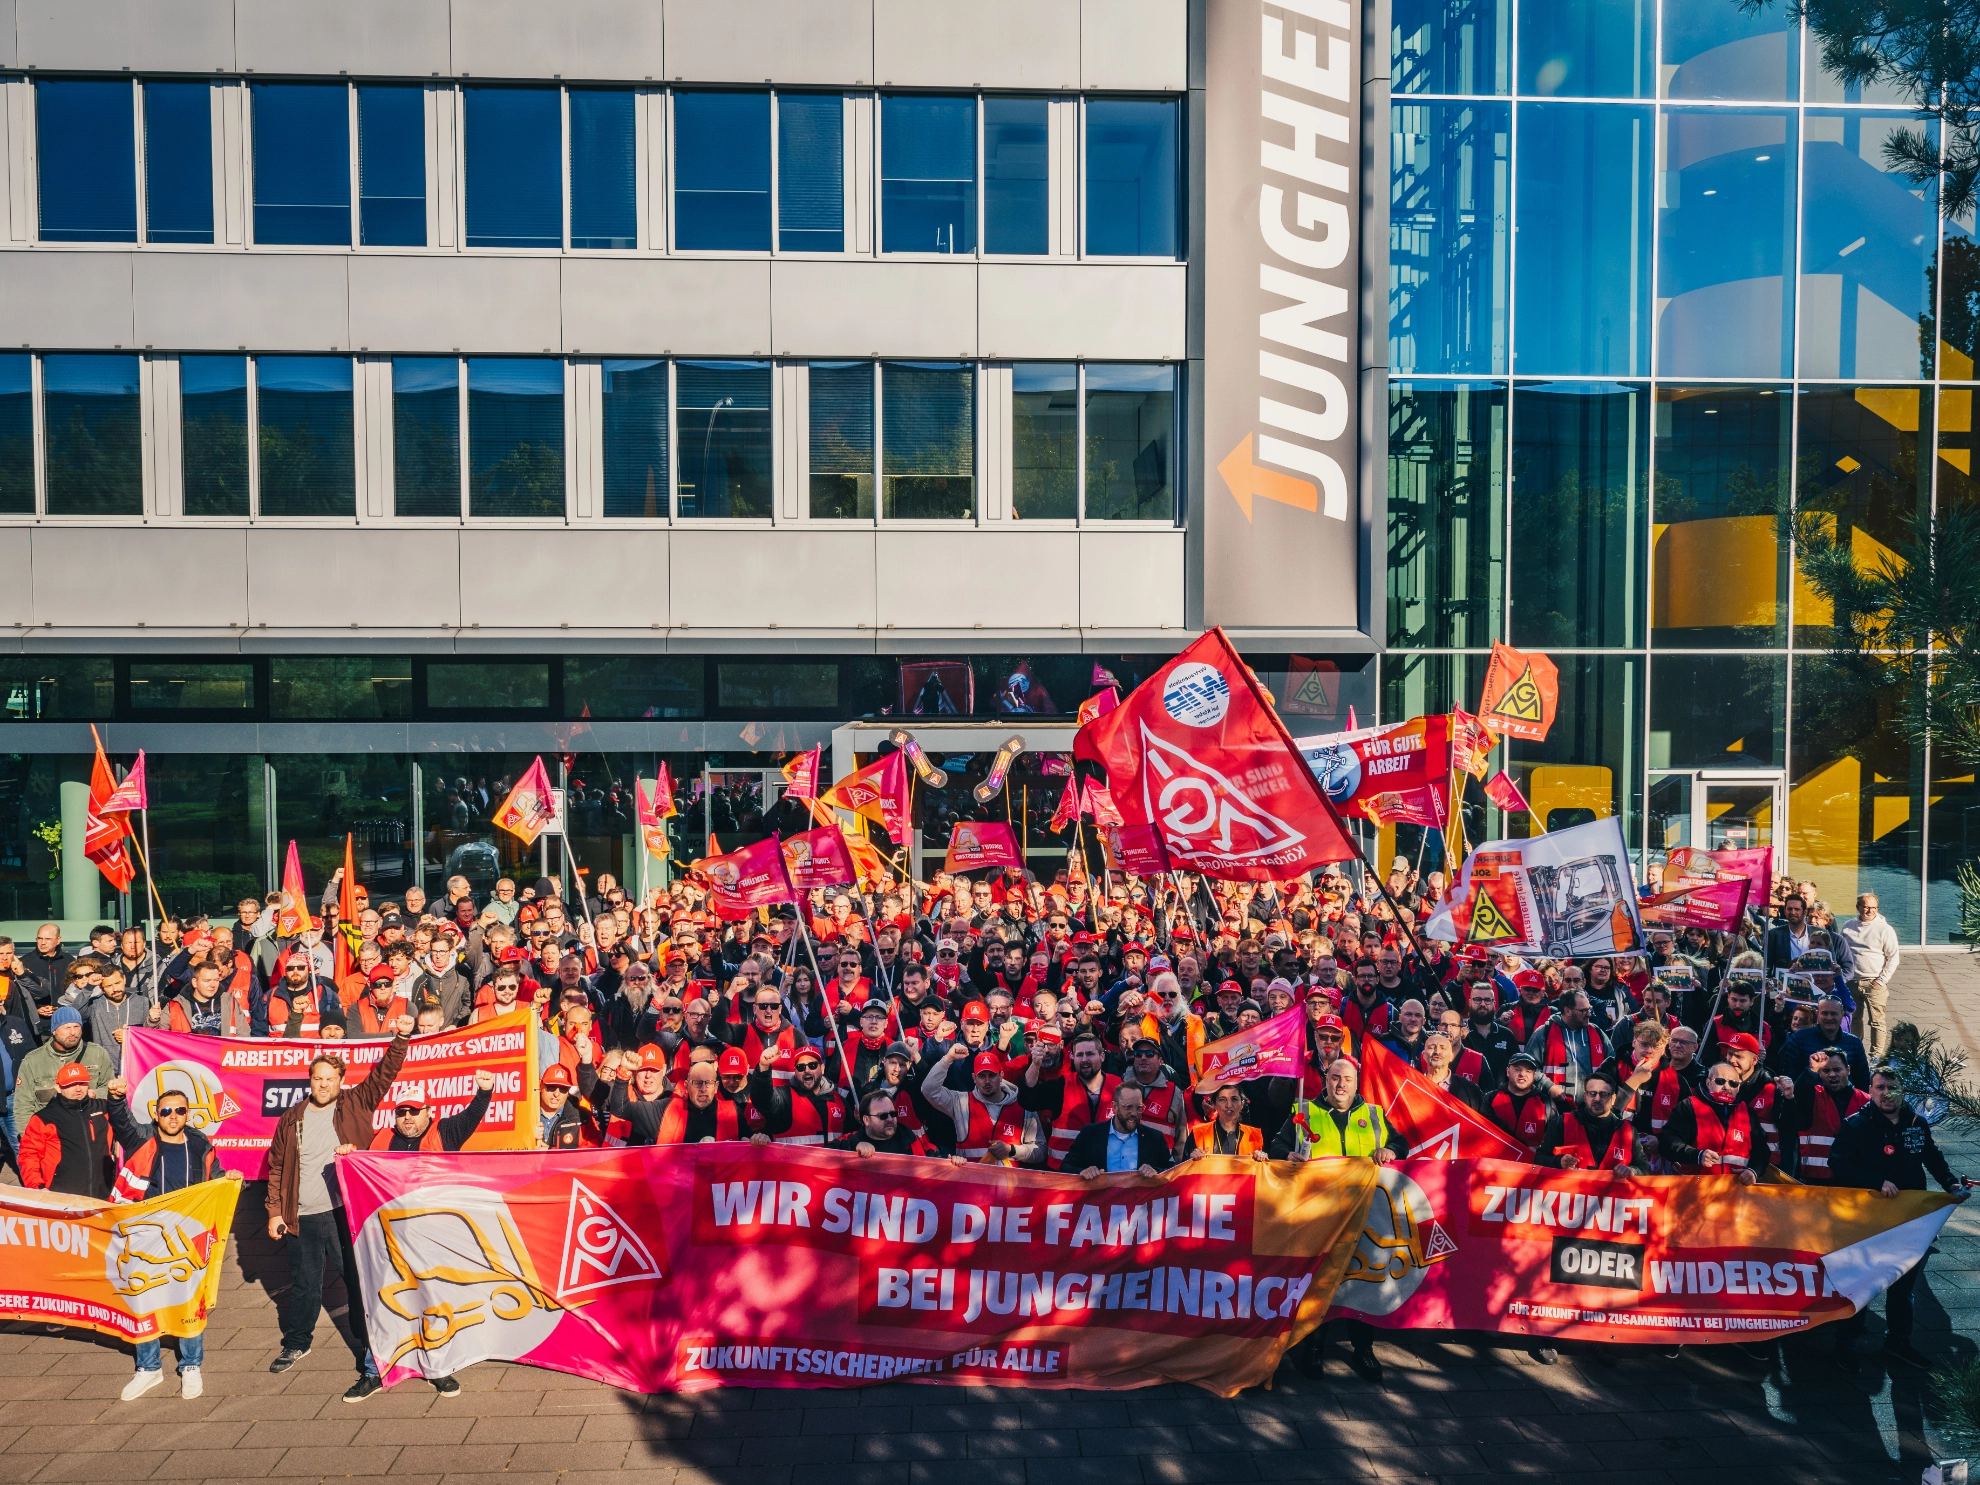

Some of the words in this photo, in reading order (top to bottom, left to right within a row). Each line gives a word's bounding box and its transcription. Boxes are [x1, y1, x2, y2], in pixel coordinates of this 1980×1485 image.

[1487, 717, 1542, 736] STILL
[1363, 735, 1391, 759] FÜR
[1392, 732, 1423, 755] GUTE
[1245, 762, 1284, 784] SIND
[1367, 753, 1411, 777] ARBEIT
[353, 1046, 384, 1064] UND
[465, 1031, 525, 1055] SICHERN
[440, 1100, 514, 1124] KOEN!
[212, 1138, 237, 1147] PARTS
[711, 1180, 812, 1228] WIR
[821, 1187, 939, 1244] SIND
[950, 1202, 1034, 1244] DIE
[1045, 1193, 1237, 1248] FAMILIE
[1481, 1186, 1654, 1235] ZUKUNFT
[1560, 1246, 1635, 1280] ODER
[877, 1266, 956, 1311] BEI
[963, 1266, 1313, 1323] JUNGHEINRICH
[32, 1296, 86, 1316] ZUKUNFT
[87, 1304, 110, 1321] UND
[111, 1313, 154, 1334] FAMILIE
[1508, 1300, 1530, 1316] FÜR
[1531, 1305, 1580, 1321] ZUKUNFT
[1582, 1310, 1606, 1323] UND
[1608, 1312, 1702, 1330] ZUSAMMENHALT
[1703, 1317, 1723, 1329] BEI
[1724, 1317, 1809, 1331] JUNGHEINRICH
[684, 1345, 944, 1379] ZUKUNFTSSICHERHEIT
[951, 1346, 998, 1369] FÜR
[1001, 1347, 1060, 1373] ALLE
